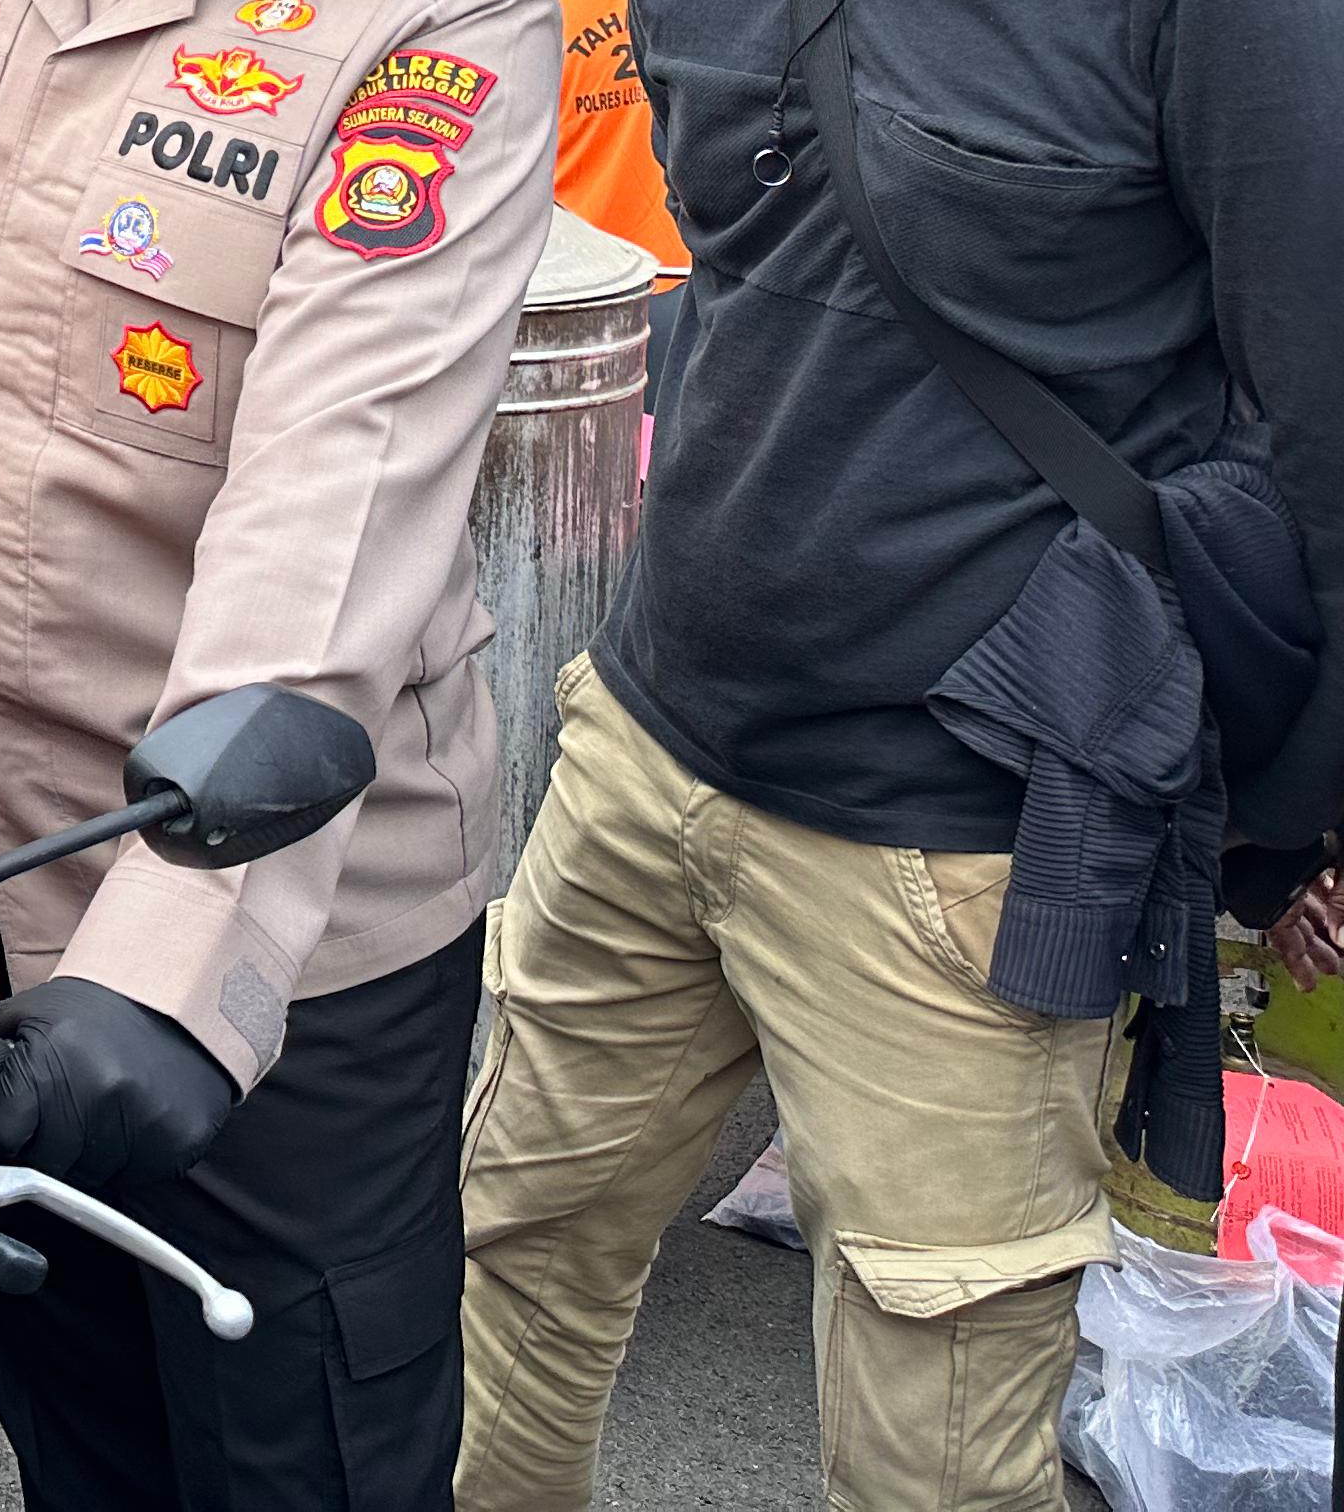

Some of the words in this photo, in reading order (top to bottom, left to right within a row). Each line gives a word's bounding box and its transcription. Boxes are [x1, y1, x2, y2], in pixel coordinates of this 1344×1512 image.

[392, 74, 474, 105] LINGGAU
[575, 90, 621, 114] POLRES
[342, 107, 405, 131] SUMATERA
[407, 109, 461, 141] SELATAN
[118, 110, 279, 201] POLRI
